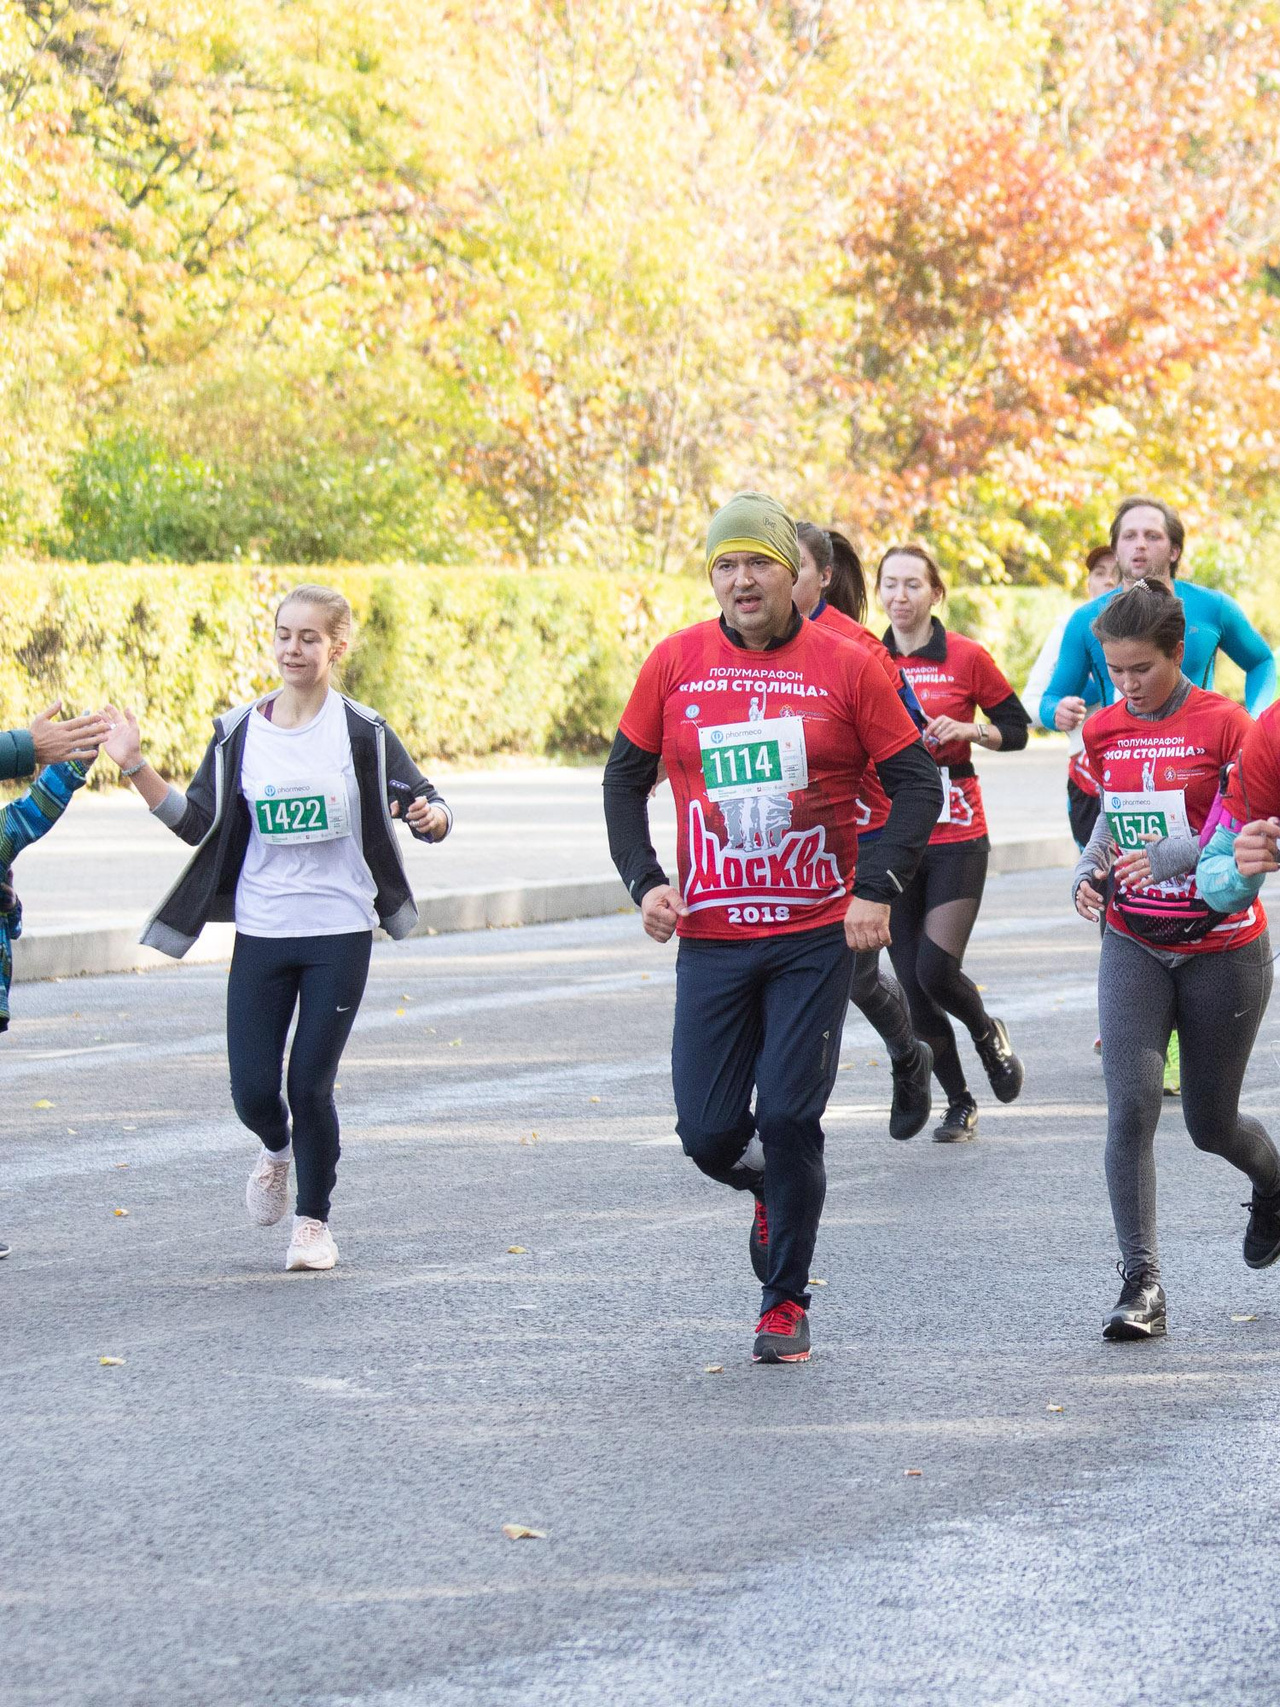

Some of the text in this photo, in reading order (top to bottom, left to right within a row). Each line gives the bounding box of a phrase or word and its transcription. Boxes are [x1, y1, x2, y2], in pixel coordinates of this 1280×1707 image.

[709, 667, 803, 681] ПОЛУМАРАФОН
[679, 680, 829, 697] «МОЯ СТОЛИЦА»
[725, 729, 762, 741] pharmeco
[1117, 736, 1185, 748] ПОЛУМАРАФОН
[1133, 746, 1206, 760] СТОЛИЦА»
[710, 745, 773, 784] 1114
[277, 785, 311, 793] pharmeco
[260, 799, 323, 831] 1422
[727, 906, 790, 924] 2018
